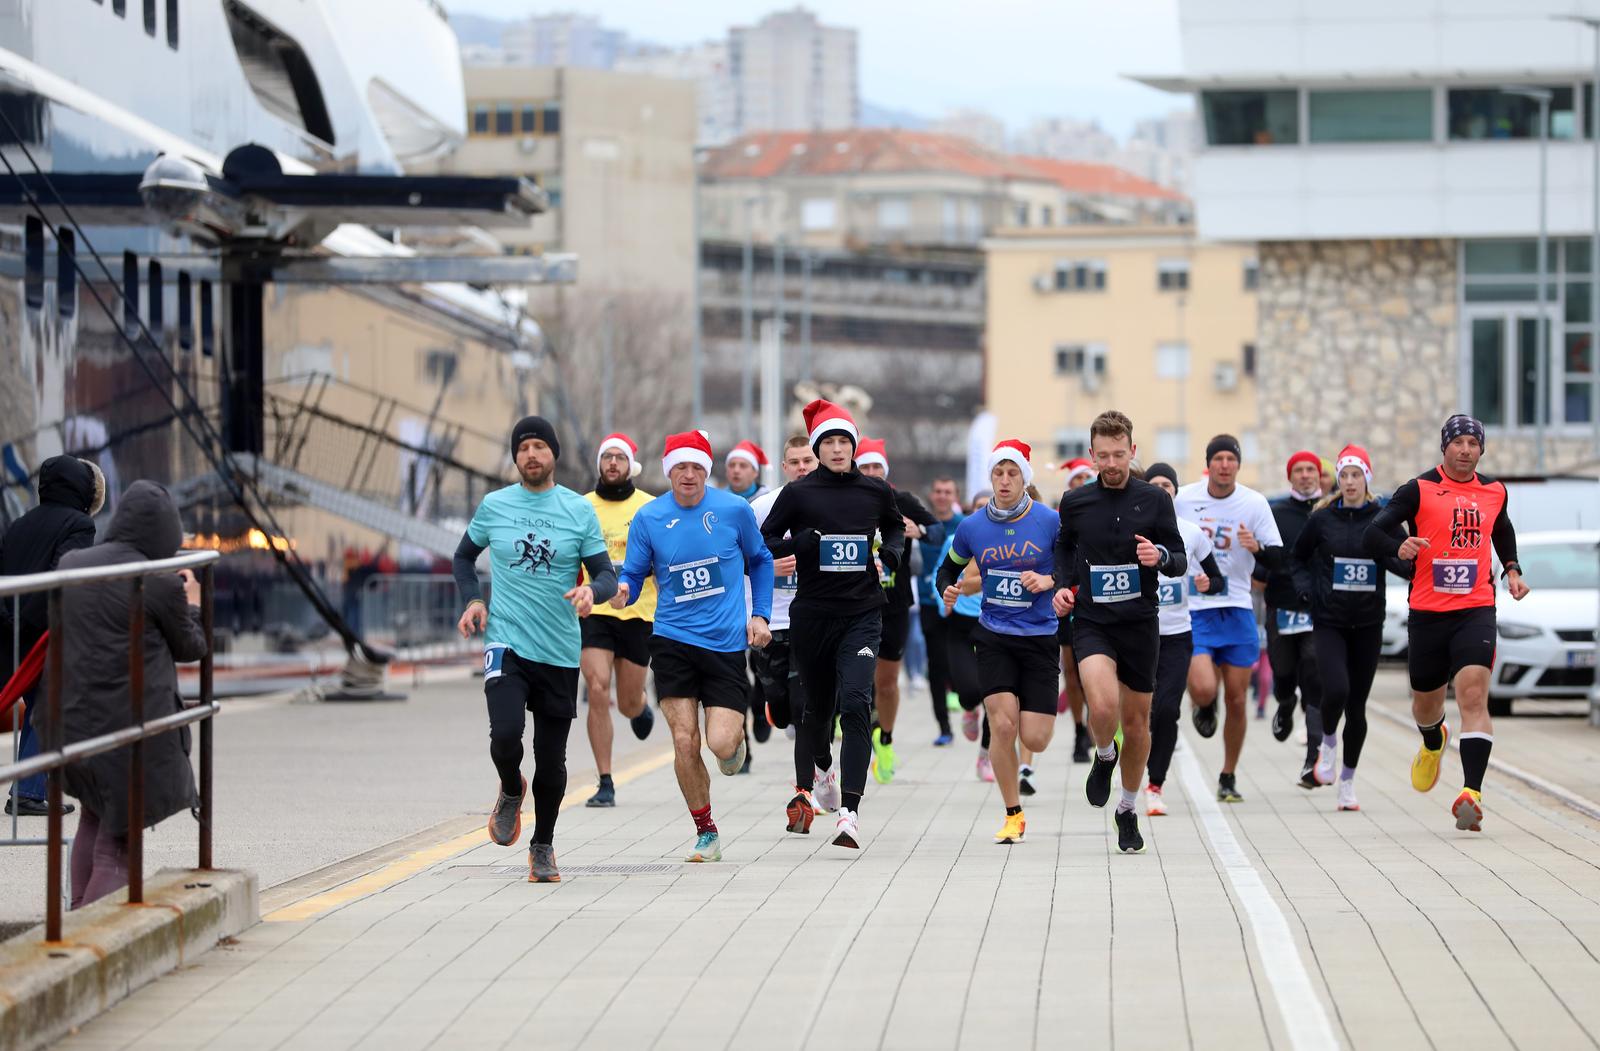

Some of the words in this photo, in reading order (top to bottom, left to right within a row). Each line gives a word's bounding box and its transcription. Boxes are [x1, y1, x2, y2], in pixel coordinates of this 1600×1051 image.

[831, 542, 858, 561] 30
[980, 540, 1042, 565] RIKA
[682, 567, 711, 589] 89
[1101, 571, 1131, 591] 28
[1343, 564, 1369, 581] 38
[1443, 565, 1470, 584] 32
[995, 577, 1023, 597] 46
[1285, 610, 1310, 625] 75
